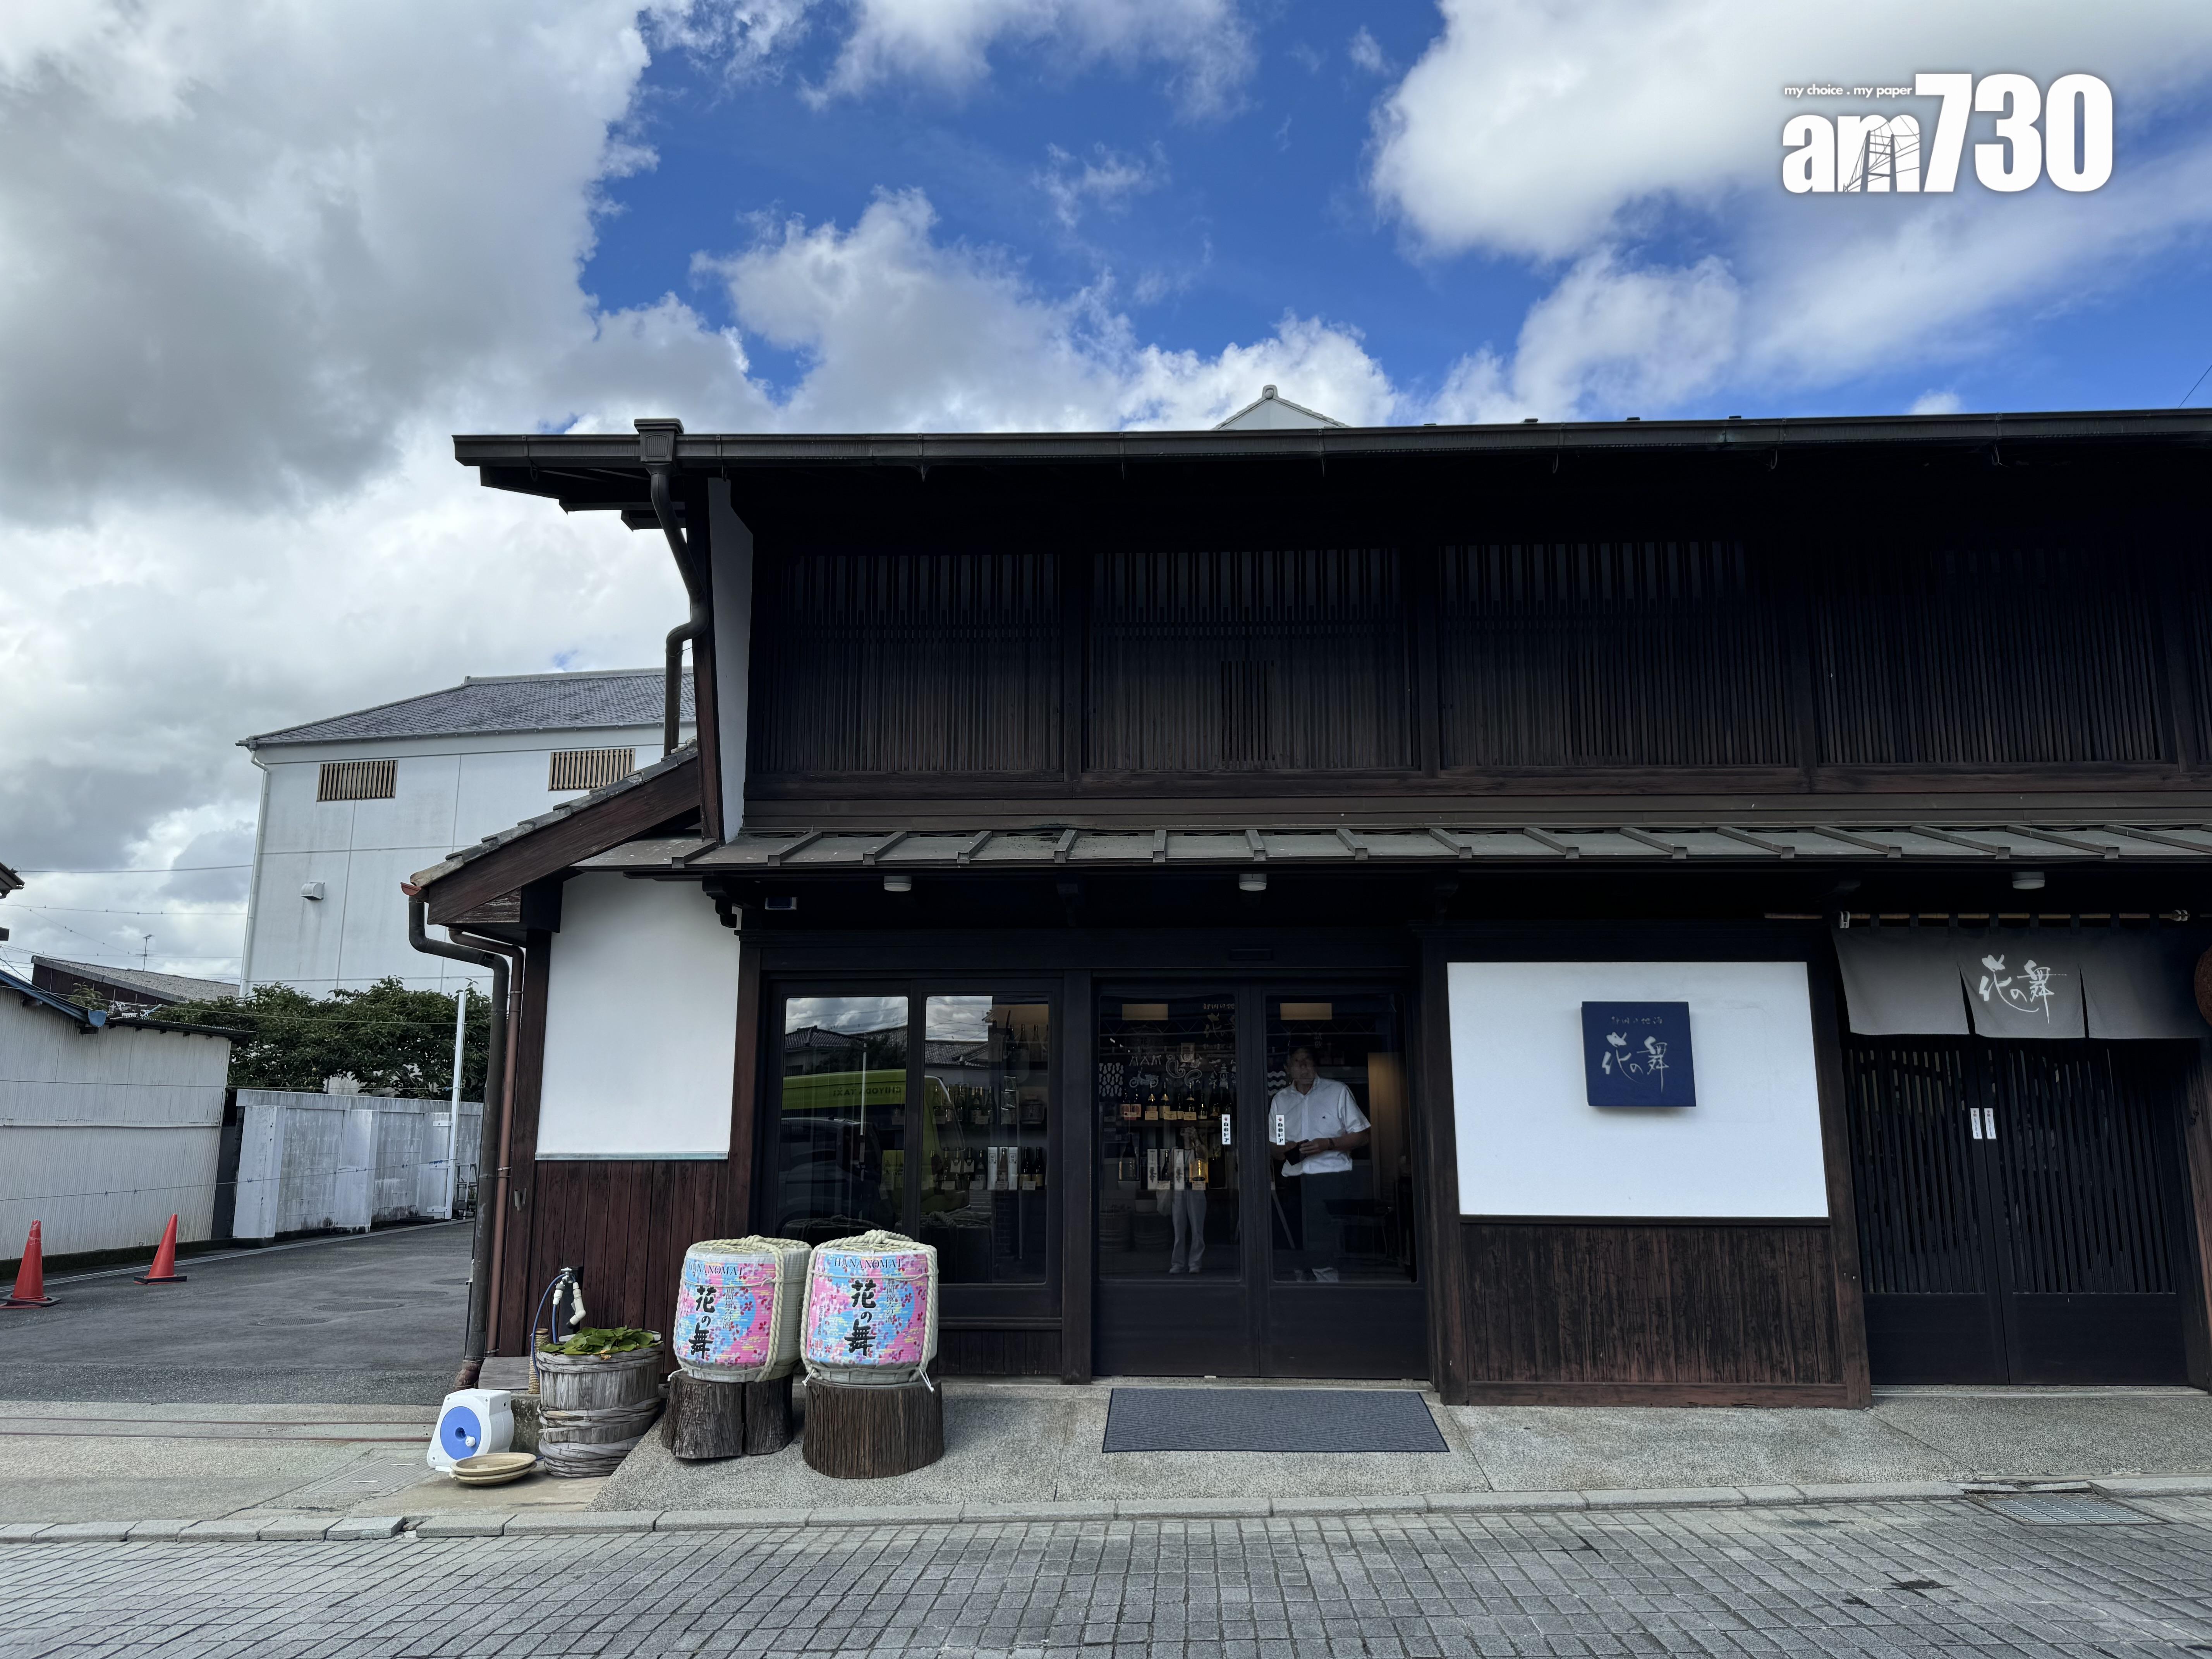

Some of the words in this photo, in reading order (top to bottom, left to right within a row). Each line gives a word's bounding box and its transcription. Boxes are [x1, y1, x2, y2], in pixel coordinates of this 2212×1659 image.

[1979, 954, 2067, 1024] 花の舞
[1601, 1031, 1669, 1093] 花の舞
[688, 1262, 743, 1276] HANANOMAI
[834, 1257, 901, 1269] HANANOMAI
[688, 1285, 717, 1360] 花の舞
[844, 1279, 877, 1357] 花の舞
